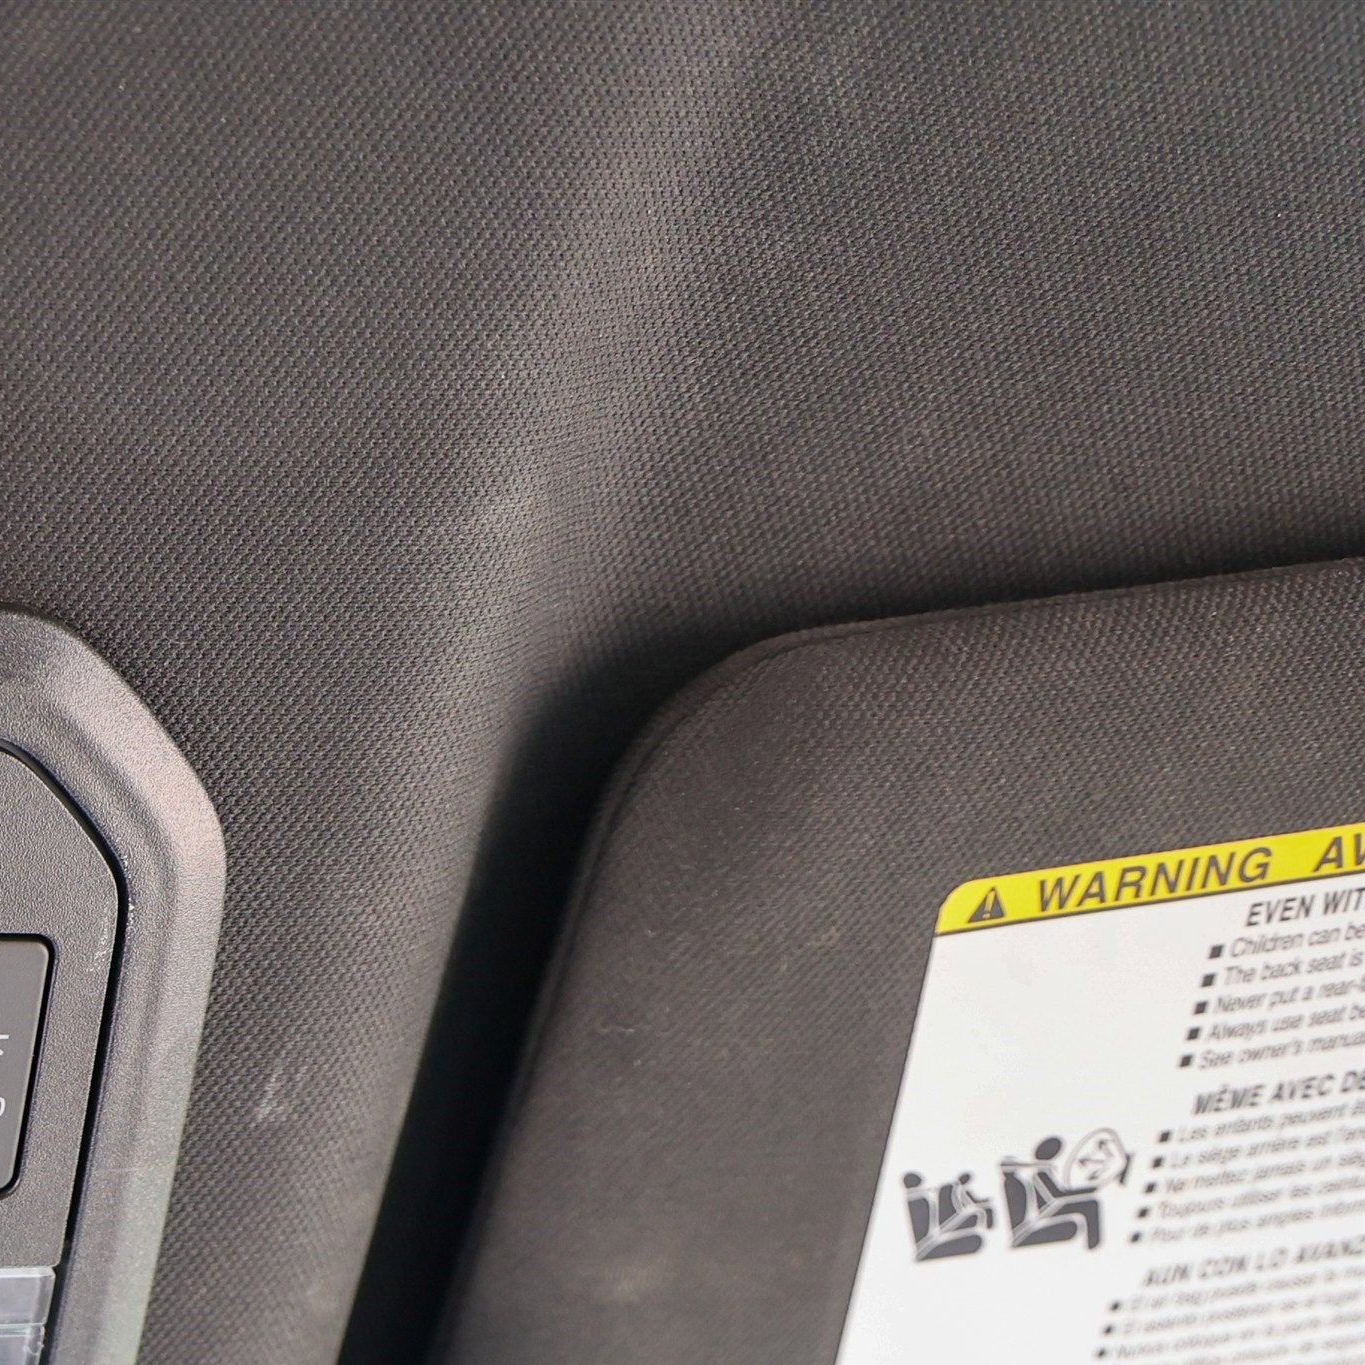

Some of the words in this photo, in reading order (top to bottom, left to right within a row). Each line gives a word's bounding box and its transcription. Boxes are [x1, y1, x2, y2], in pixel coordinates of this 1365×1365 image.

[1038, 846, 1273, 912] WARNING
[1246, 894, 1315, 927] EVEN
[1230, 932, 1304, 958] Children
[1307, 927, 1342, 947] can
[1223, 965, 1258, 986] The
[1260, 957, 1302, 981] back
[1306, 950, 1347, 974] seat
[1214, 990, 1267, 1014] Never
[1317, 974, 1365, 998] rear-
[1207, 1017, 1268, 1043] Always
